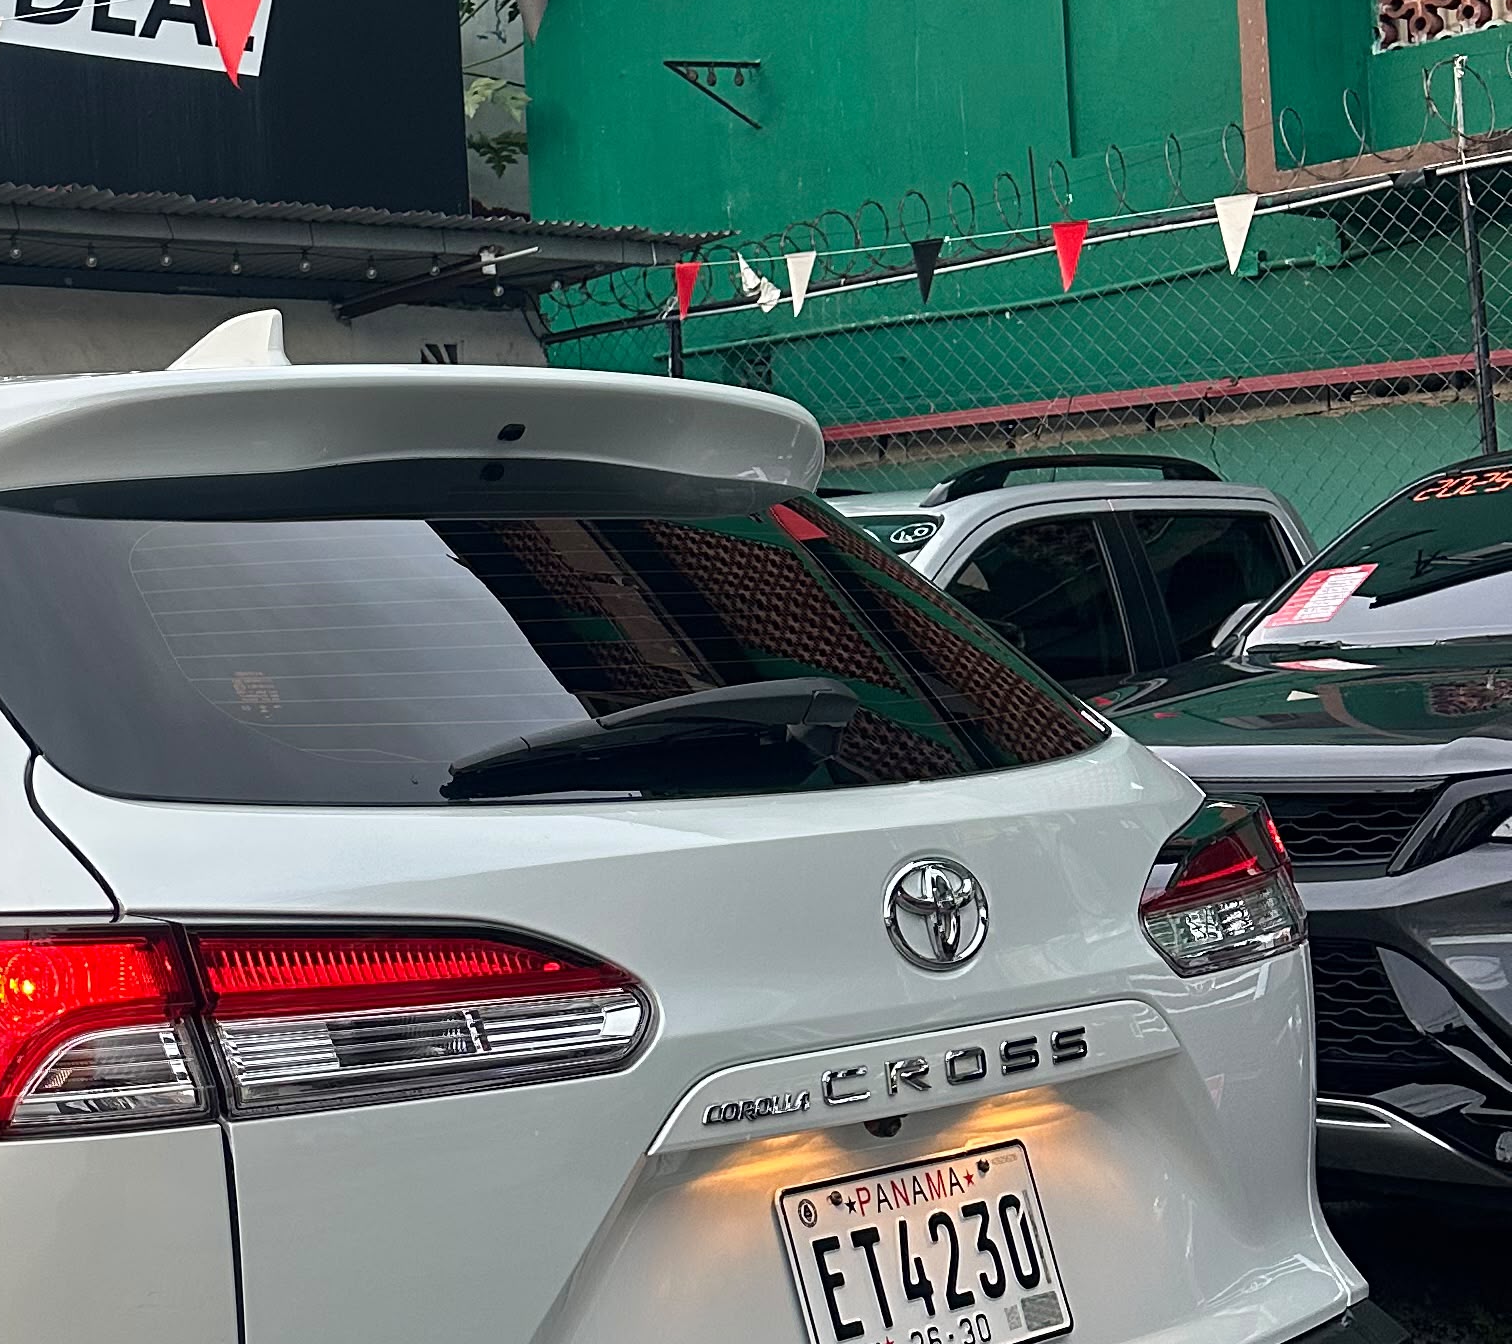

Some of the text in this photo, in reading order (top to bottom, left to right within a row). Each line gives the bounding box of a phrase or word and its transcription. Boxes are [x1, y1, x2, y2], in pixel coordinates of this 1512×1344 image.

[701, 1026, 1088, 1126] COROLLA CROSS
[855, 1167, 965, 1217] PANAMA
[811, 1193, 1041, 1342] ET4230
